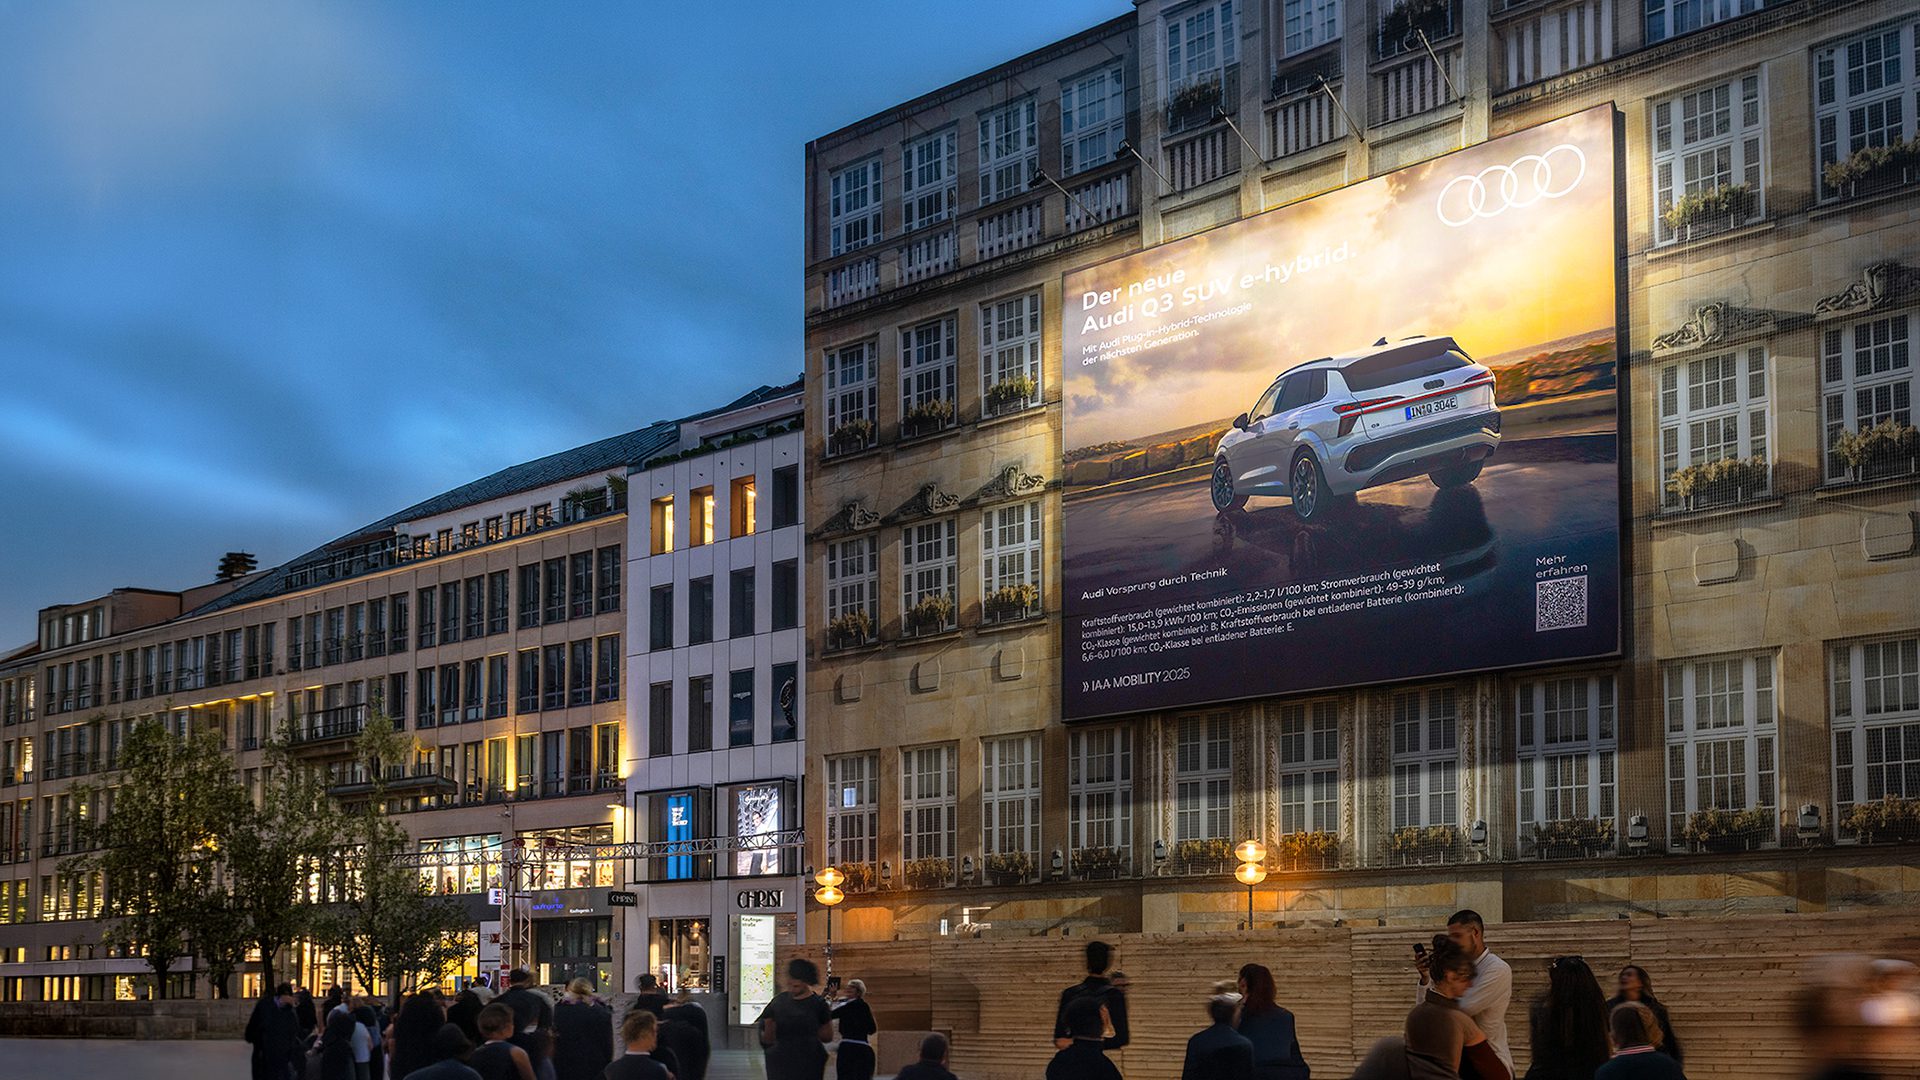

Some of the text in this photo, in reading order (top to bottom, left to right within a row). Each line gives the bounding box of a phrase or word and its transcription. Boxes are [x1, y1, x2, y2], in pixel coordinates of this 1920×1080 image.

[1081, 240, 1357, 335] Audi Q3 SUV e-hybrid.
[1082, 269, 1186, 310] Der neue
[1082, 301, 1252, 355] Mit Audi Plug-in-Hybrid-Technologie
[1082, 329, 1200, 366] der nächsten Generation.
[1411, 404, 1422, 418] IN
[1433, 397, 1457, 412] 304E
[1535, 554, 1567, 567] Mehr
[1535, 564, 1588, 578] erfahren
[1081, 567, 1228, 600] Audi Vorsprung durch Technik
[1082, 608, 1153, 628] Kraftstoffverbrauch
[1155, 603, 1195, 618] (gewichtet
[1197, 594, 1245, 610] kombiniert):
[1303, 583, 1319, 593] km;
[1321, 571, 1391, 590] Stromverbrauch
[1393, 562, 1441, 580] (gewichtet
[1082, 625, 1125, 639] kombiniert):
[1164, 612, 1201, 627] kWh/100
[1203, 611, 1218, 621] km;
[1284, 594, 1329, 609] (gewichtet
[1331, 584, 1384, 600] kombiniert):
[1417, 575, 1445, 590] g/km;
[1122, 631, 1160, 646] (gewichtet
[1162, 623, 1209, 638] kombiniert):
[1220, 609, 1301, 630] Kraftstoffverbrauch
[1303, 606, 1316, 618] bei
[1317, 601, 1365, 615] entladener
[1366, 594, 1402, 608] Batterie
[1404, 584, 1465, 602] (kombiniert):
[1191, 635, 1203, 645] bei
[1204, 629, 1248, 644] entladener
[1249, 624, 1285, 637] Batterie:
[1286, 622, 1295, 632] E.
[1091, 667, 1191, 692] IAA MOBILITY 2025
[737, 889, 784, 909] CHRIST
